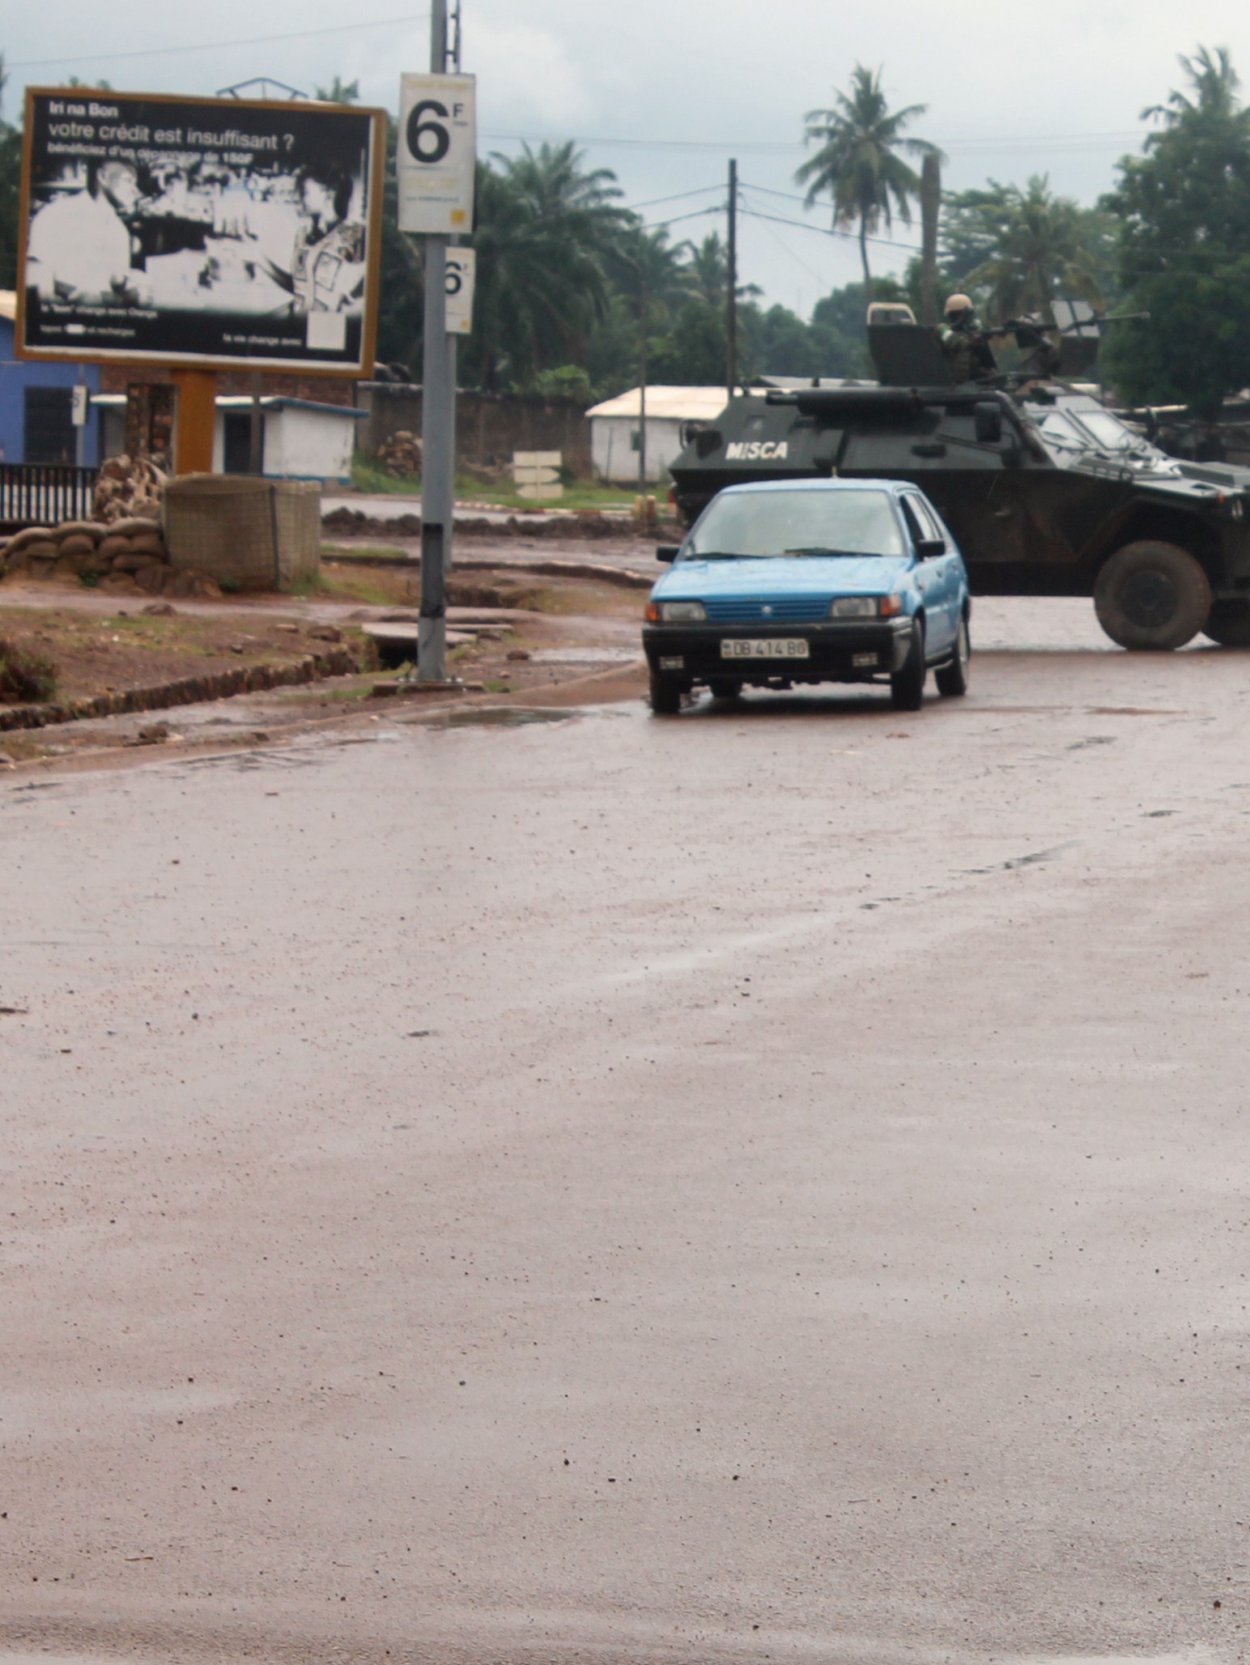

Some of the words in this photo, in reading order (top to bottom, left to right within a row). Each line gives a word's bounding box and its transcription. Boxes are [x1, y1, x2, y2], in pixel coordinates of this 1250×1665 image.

[67, 104, 85, 116] na
[88, 102, 118, 117] Bon
[48, 122, 94, 138] votre
[99, 123, 149, 142] crédit
[154, 127, 182, 143] est
[187, 127, 278, 151] insuffisant
[283, 133, 294, 151] ?
[406, 99, 449, 163] 6
[453, 104, 464, 118] F
[726, 441, 788, 460] MISCA
[756, 641, 783, 655] 414
